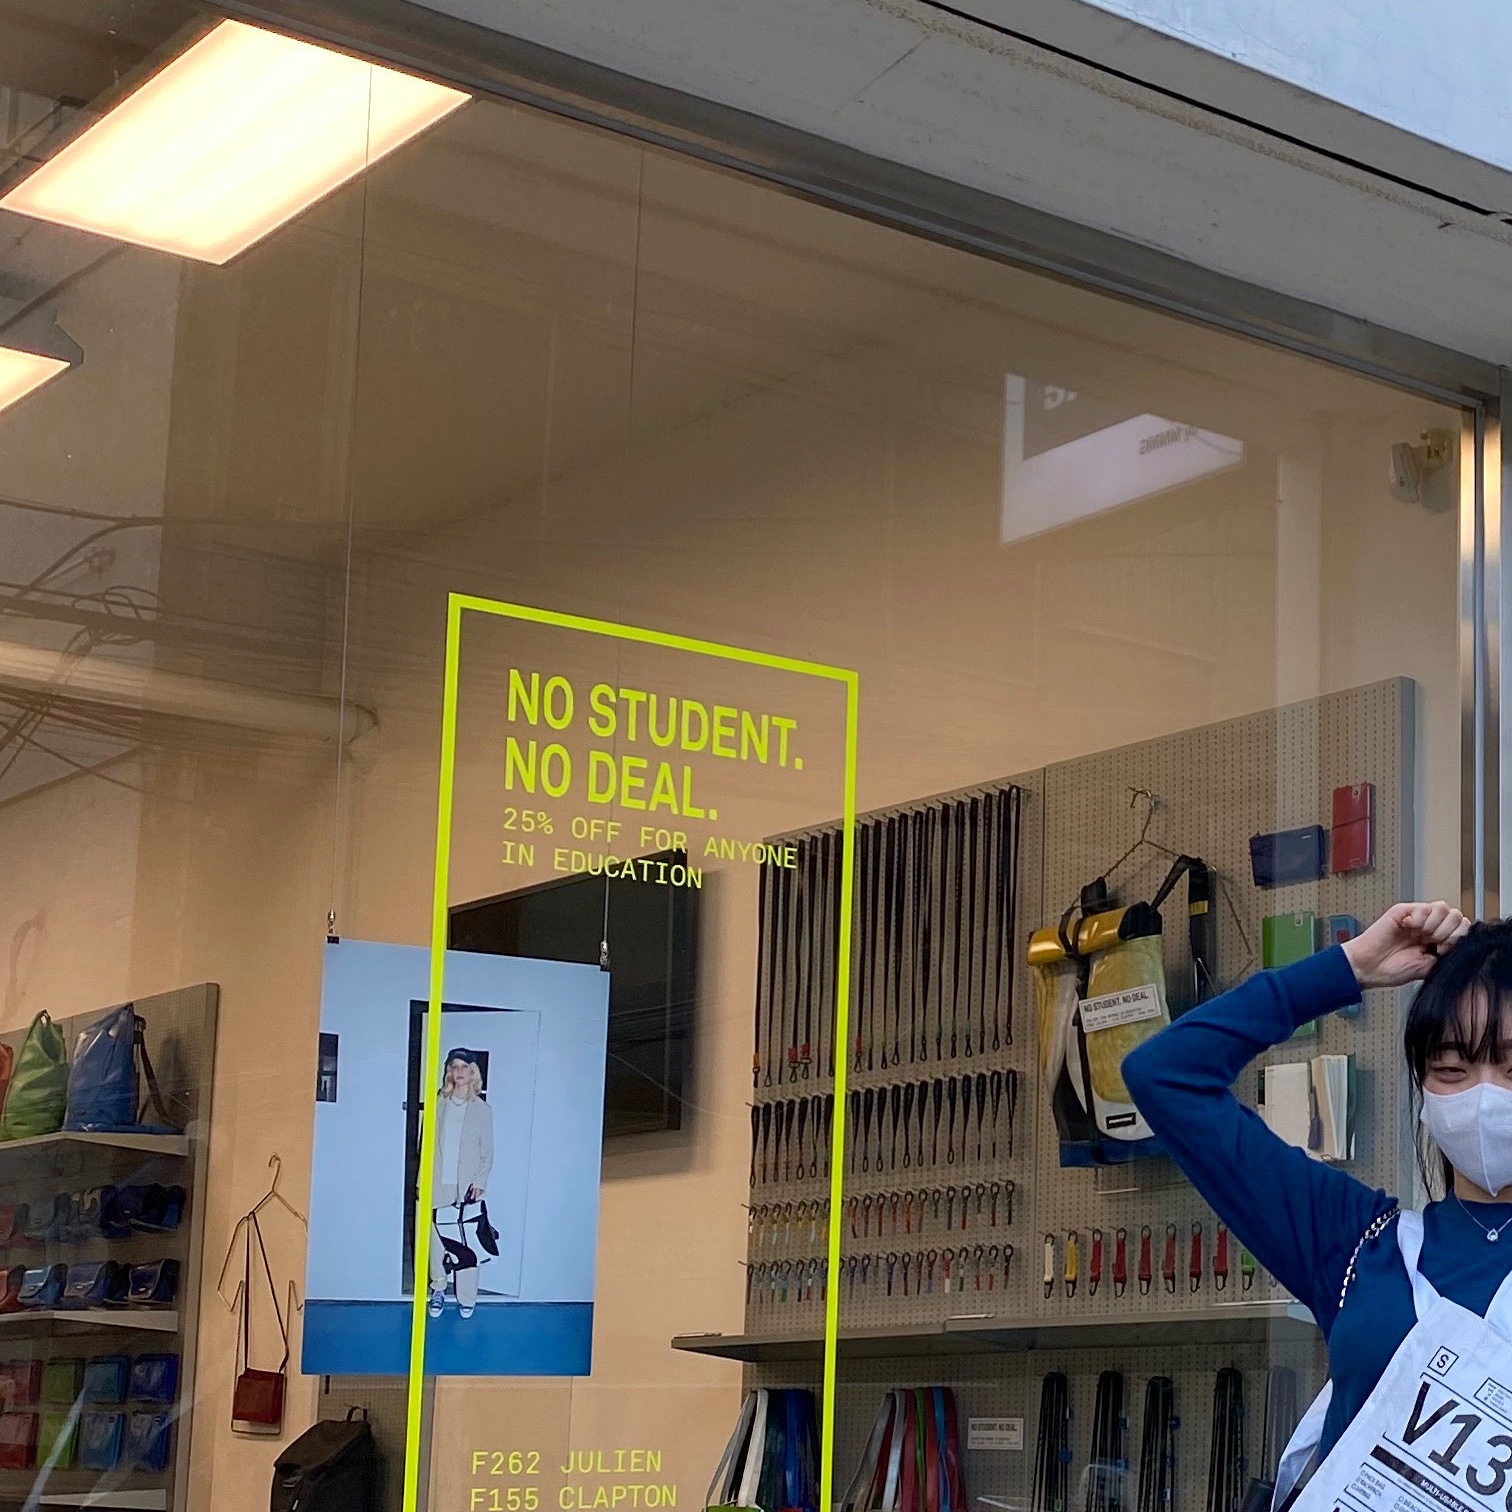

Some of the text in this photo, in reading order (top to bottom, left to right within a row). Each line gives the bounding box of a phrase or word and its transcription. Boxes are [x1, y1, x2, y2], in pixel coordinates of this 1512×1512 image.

[508, 669, 803, 770] NO STUDENT.
[505, 737, 718, 821] NO DEAL.
[503, 807, 798, 869] 25% OFF FOR ANYONE
[501, 840, 703, 889] IN EDUCATION
[1436, 1354, 1449, 1370] S
[472, 1450, 662, 1475] F262 JULIEN
[470, 1484, 677, 1512] F155 CLAPTON
